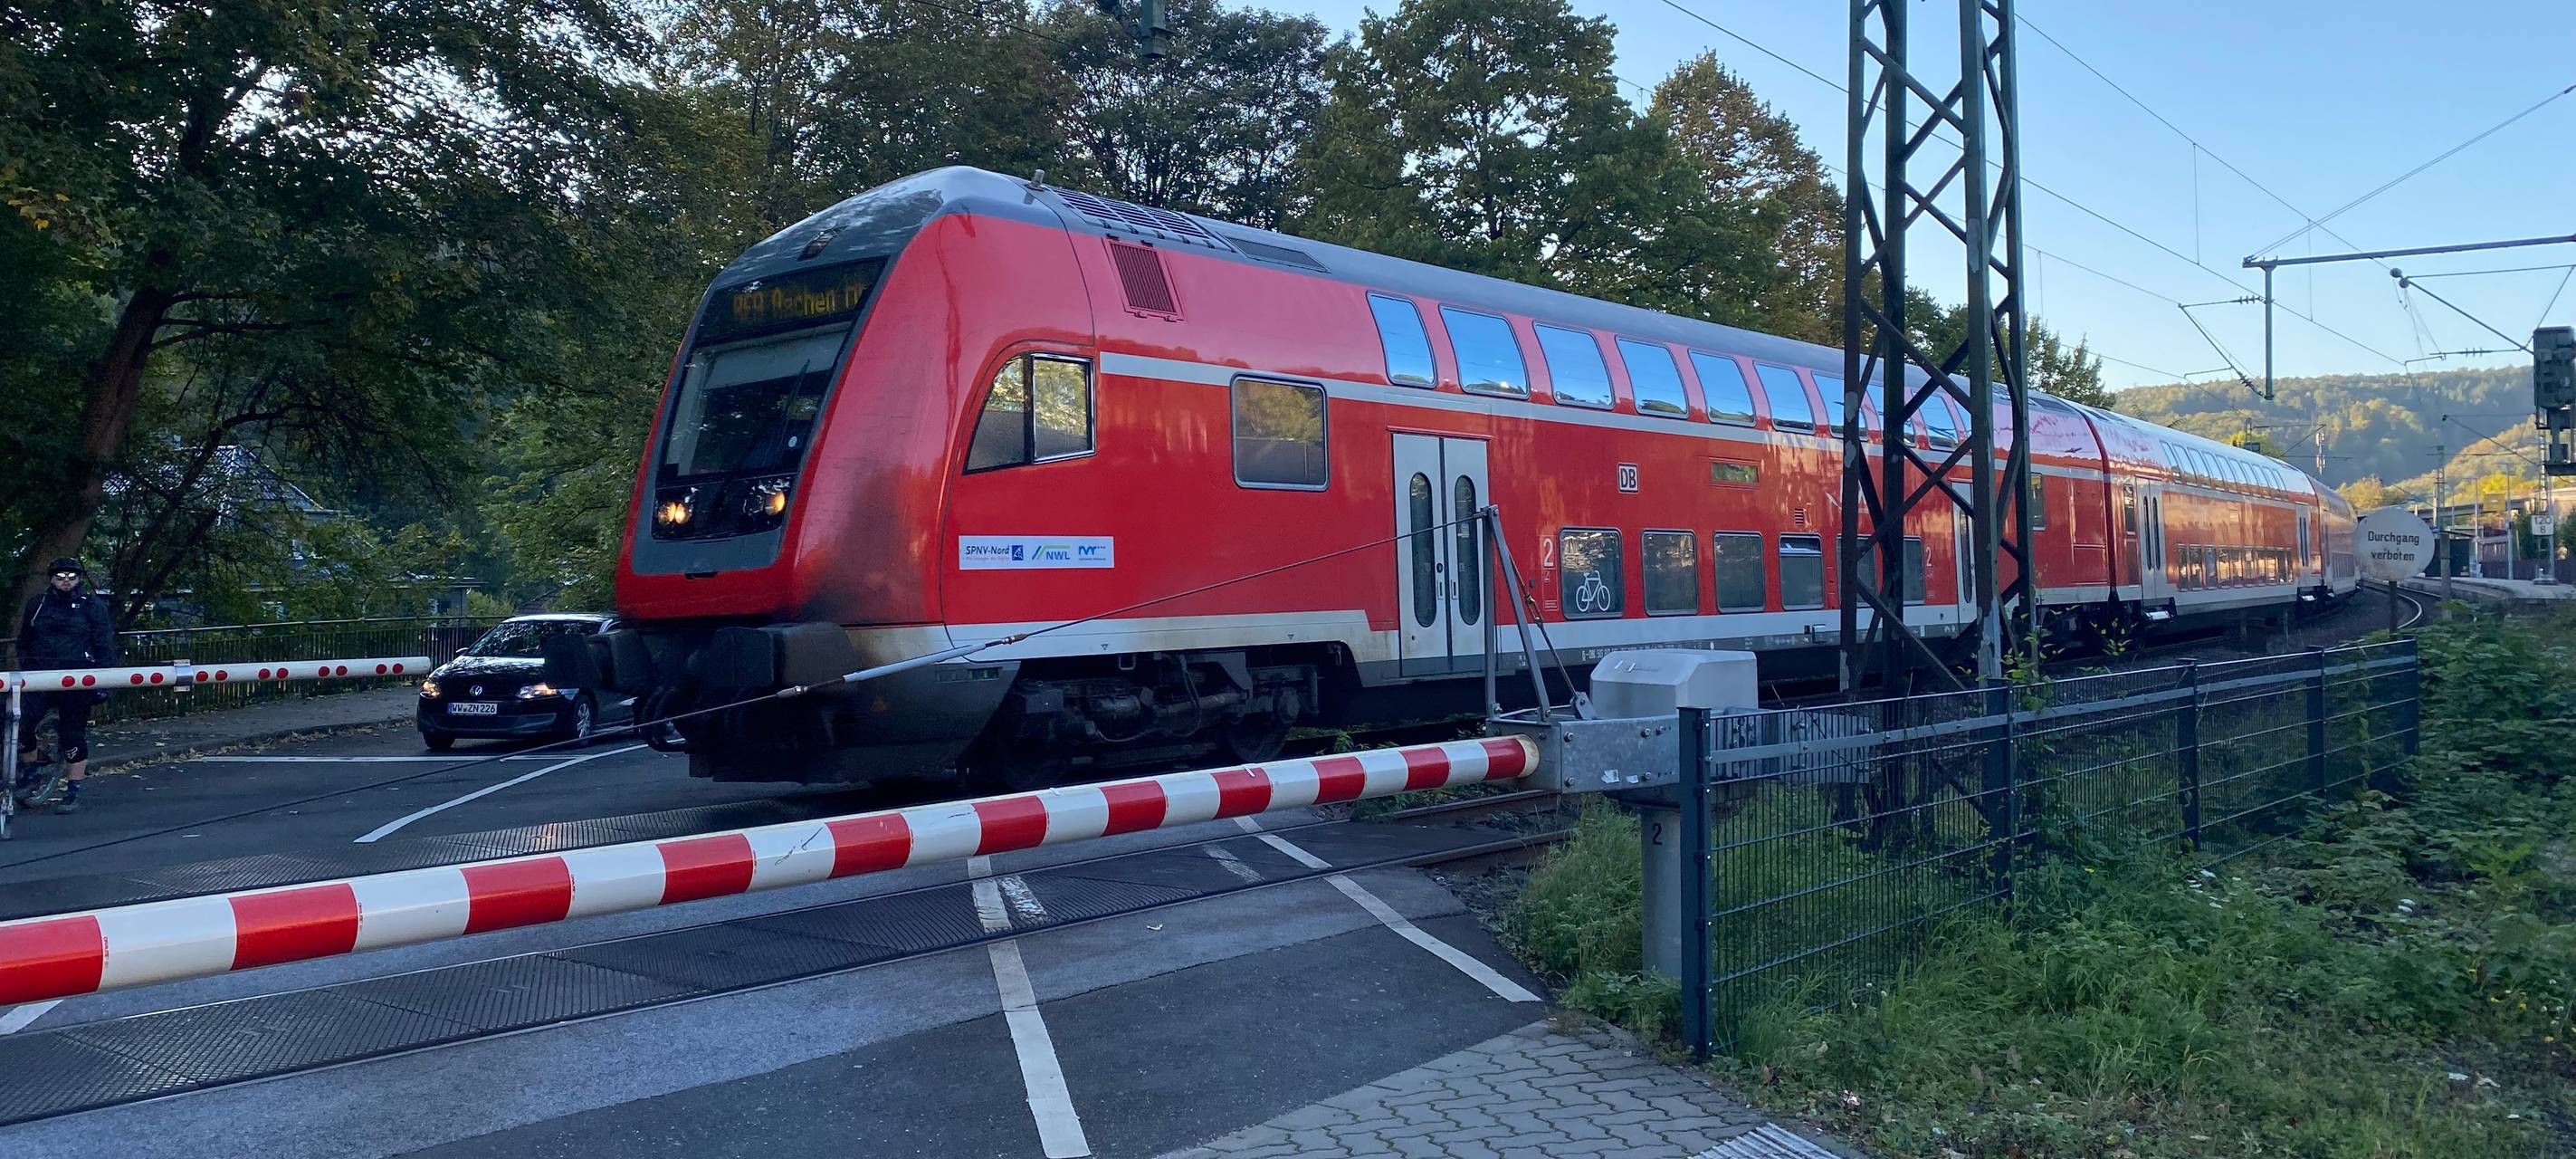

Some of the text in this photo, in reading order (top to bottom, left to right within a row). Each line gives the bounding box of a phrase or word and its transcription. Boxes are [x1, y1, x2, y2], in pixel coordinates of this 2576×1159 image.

[1620, 468, 1636, 488] DB
[2534, 516, 2552, 525] 120
[2540, 525, 2546, 534] 8
[2368, 531, 2420, 546] Durchgang
[966, 545, 1010, 555] SPNV-Nord
[1045, 551, 1071, 560] NWL
[1543, 538, 1554, 567] 2
[2371, 549, 2415, 561] verboten
[1925, 546, 1932, 567] 2
[468, 704, 479, 713] ZN
[480, 704, 496, 714] 226
[1653, 822, 1663, 847] 2
